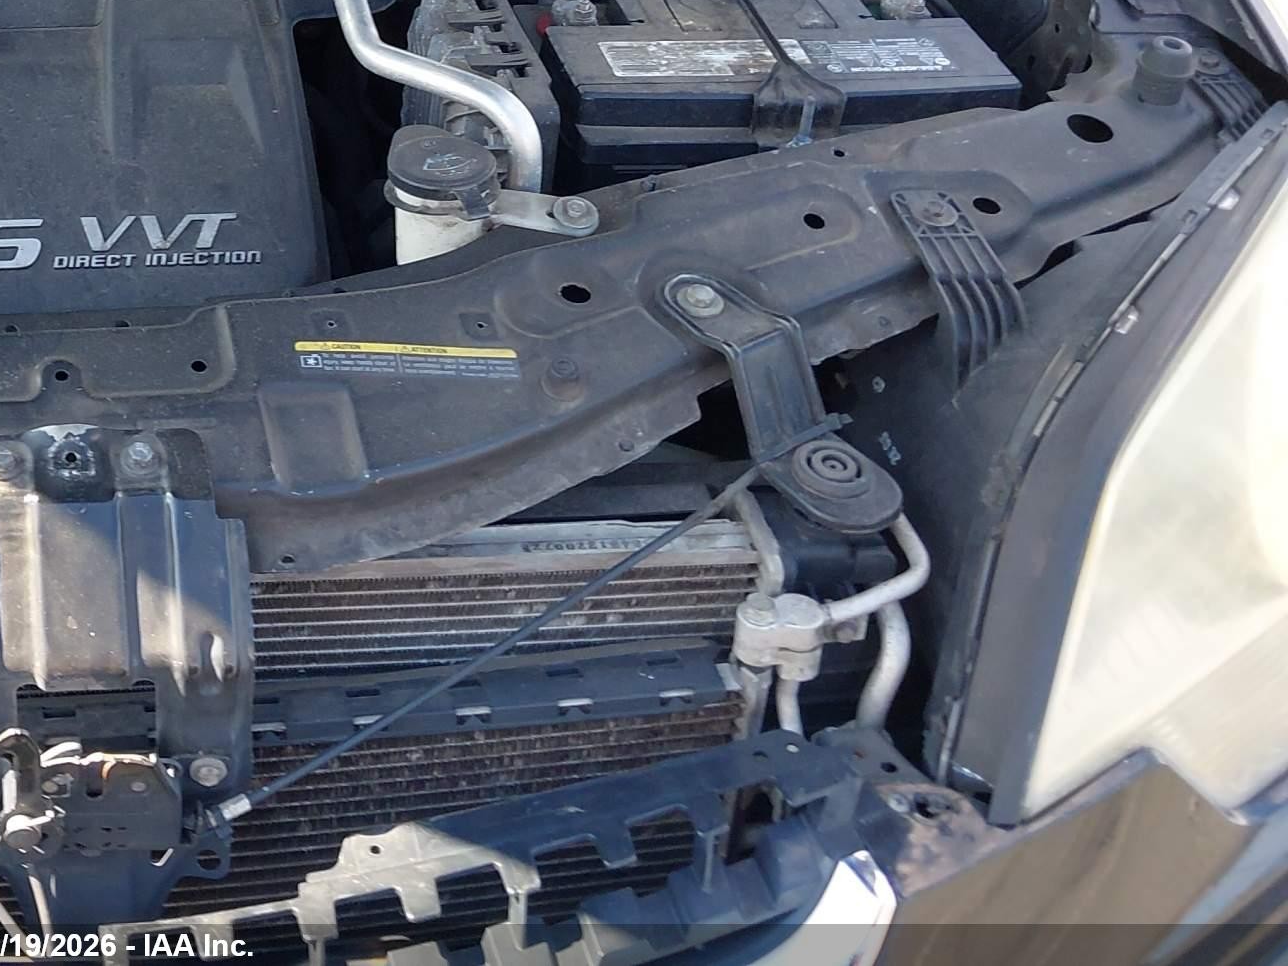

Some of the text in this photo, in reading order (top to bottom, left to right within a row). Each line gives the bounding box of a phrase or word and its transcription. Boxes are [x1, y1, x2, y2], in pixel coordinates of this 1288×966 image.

[80, 212, 238, 252] VVT
[53, 250, 262, 268] DIRECT INJECTION
